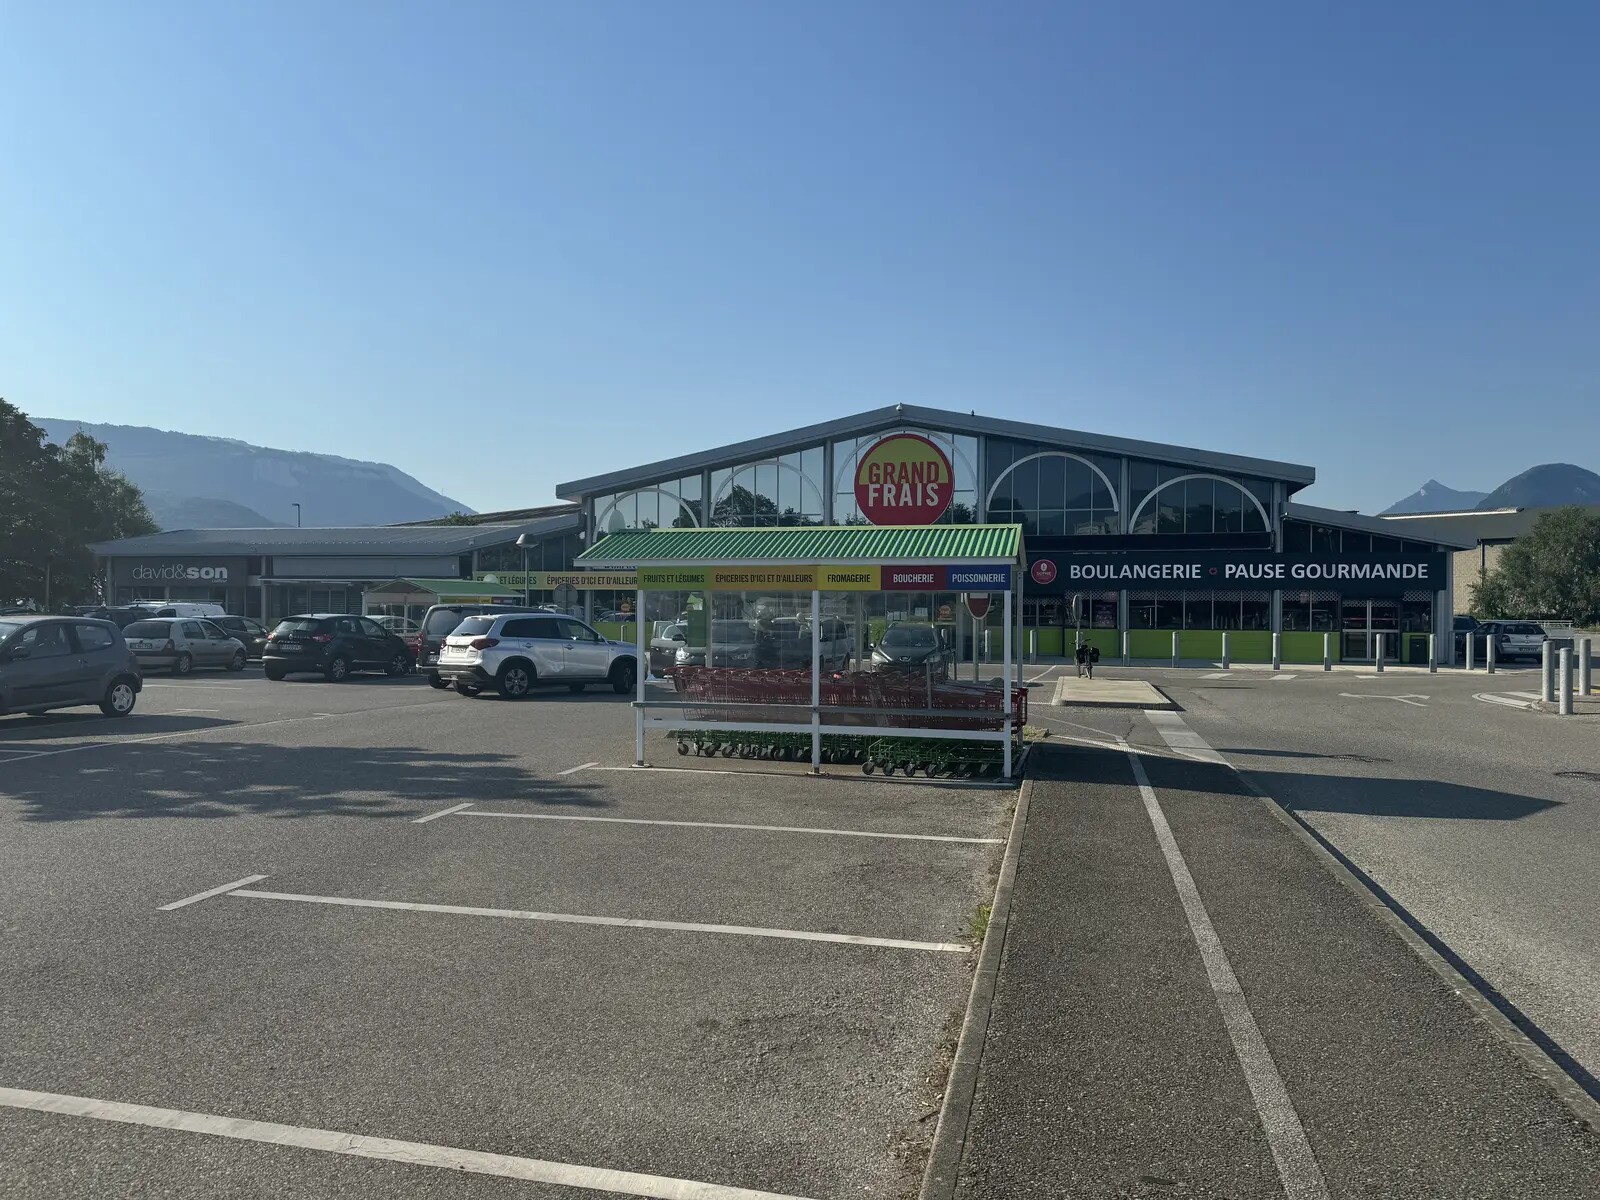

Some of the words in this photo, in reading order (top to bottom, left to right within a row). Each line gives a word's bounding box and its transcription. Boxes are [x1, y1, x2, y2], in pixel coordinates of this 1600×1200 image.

[868, 461, 939, 484] GRAND
[868, 483, 939, 507] FRAIS
[1070, 564, 1202, 579] BOULANGERIE
[1225, 563, 1285, 579] PAUSE
[1291, 563, 1429, 579] GOURMANDE
[500, 576, 507, 584] ET
[581, 576, 596, 584] D'ICI
[597, 576, 606, 584] ET
[643, 574, 666, 583] FRUITS
[666, 574, 676, 583] ET
[675, 572, 705, 583] LÉGUMES
[715, 572, 750, 583] ÉPICERIES
[750, 574, 766, 583] D'ICI
[767, 574, 776, 583] ET
[776, 574, 813, 583] D'AILLEURS
[827, 573, 871, 583] FROMAGERIE
[893, 573, 934, 583] BOUCHERIE
[952, 573, 1006, 583] POISSONNERIE
